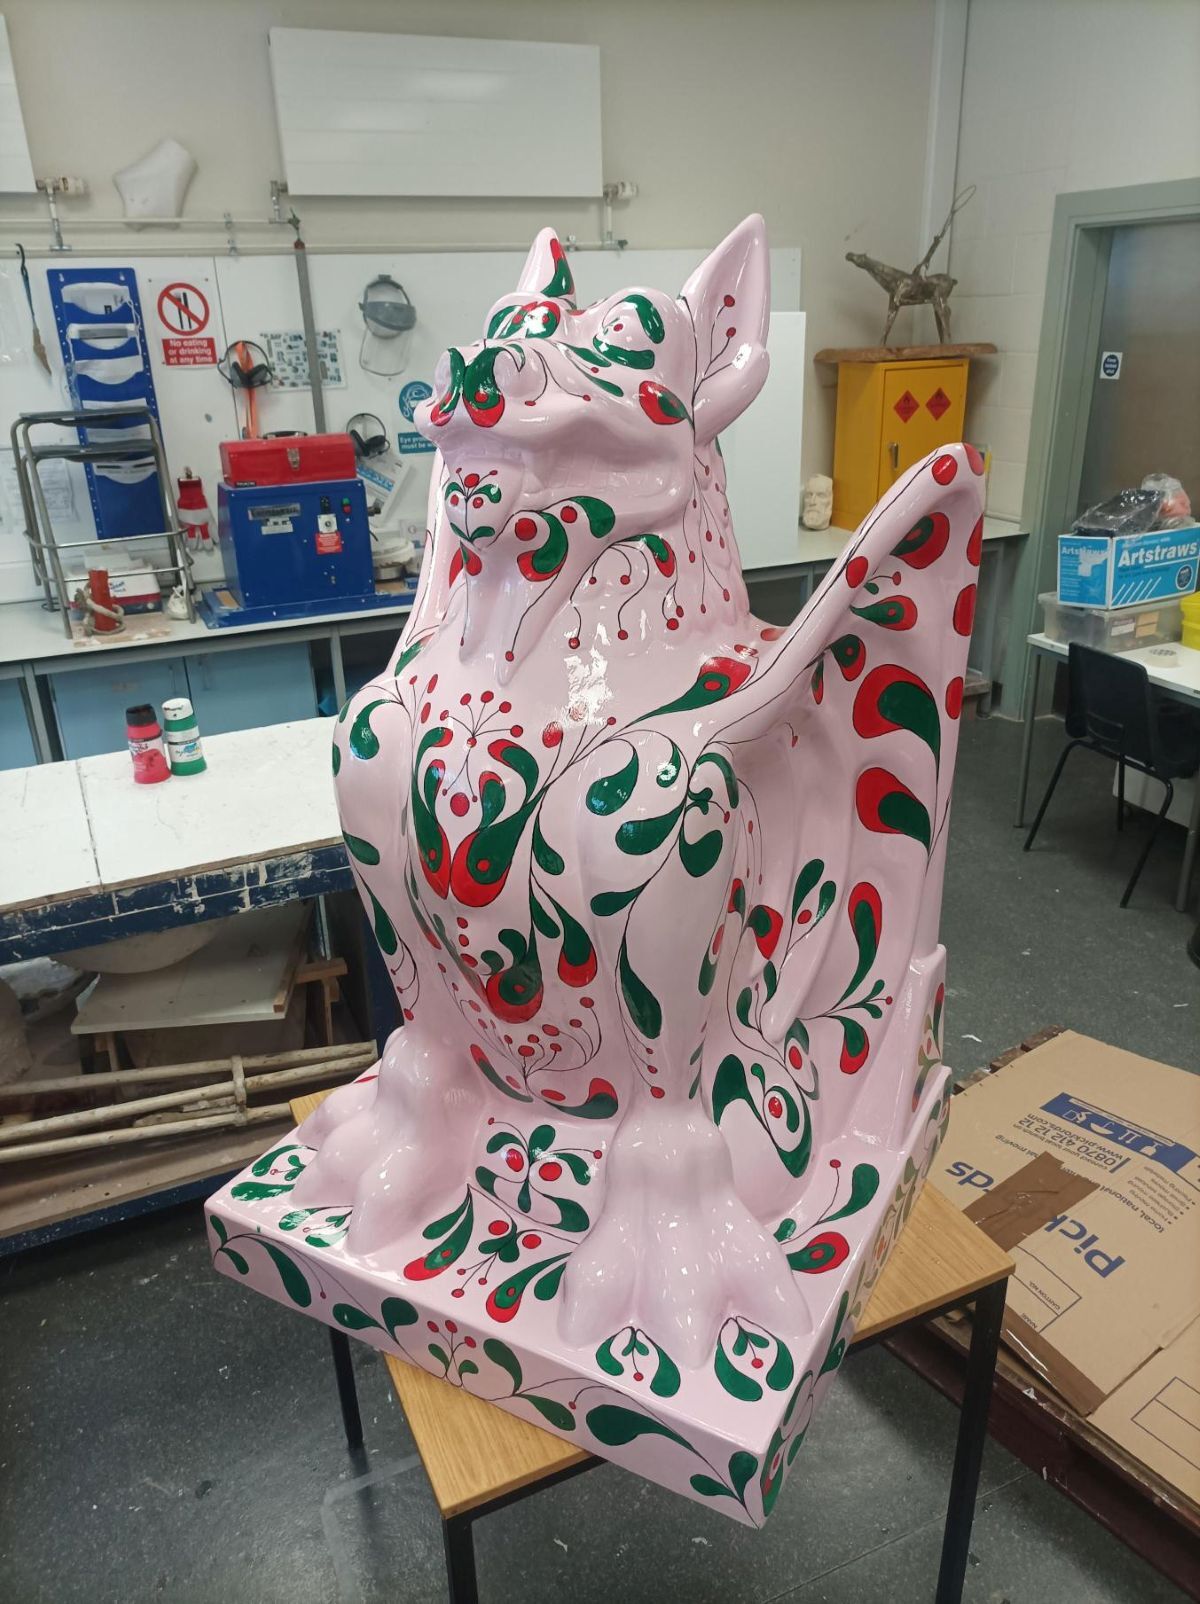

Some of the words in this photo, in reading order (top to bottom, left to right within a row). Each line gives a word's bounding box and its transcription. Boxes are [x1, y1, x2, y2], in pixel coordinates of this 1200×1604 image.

[170, 339, 182, 347] No
[183, 339, 208, 348] eating
[179, 347, 212, 356] drinking
[180, 357, 194, 366] any
[195, 355, 213, 363] time
[1118, 542, 1198, 568] Artstraws
[1018, 1117, 1034, 1129] 12
[1034, 1124, 1051, 1136] 12
[995, 1134, 1027, 1154] moving
[1027, 1113, 1122, 1160] www.pickfords.com
[1051, 1132, 1076, 1147] 412
[1077, 1145, 1116, 1166] 0870
[1101, 1185, 1139, 1212] national
[1139, 1209, 1165, 1234] local,
